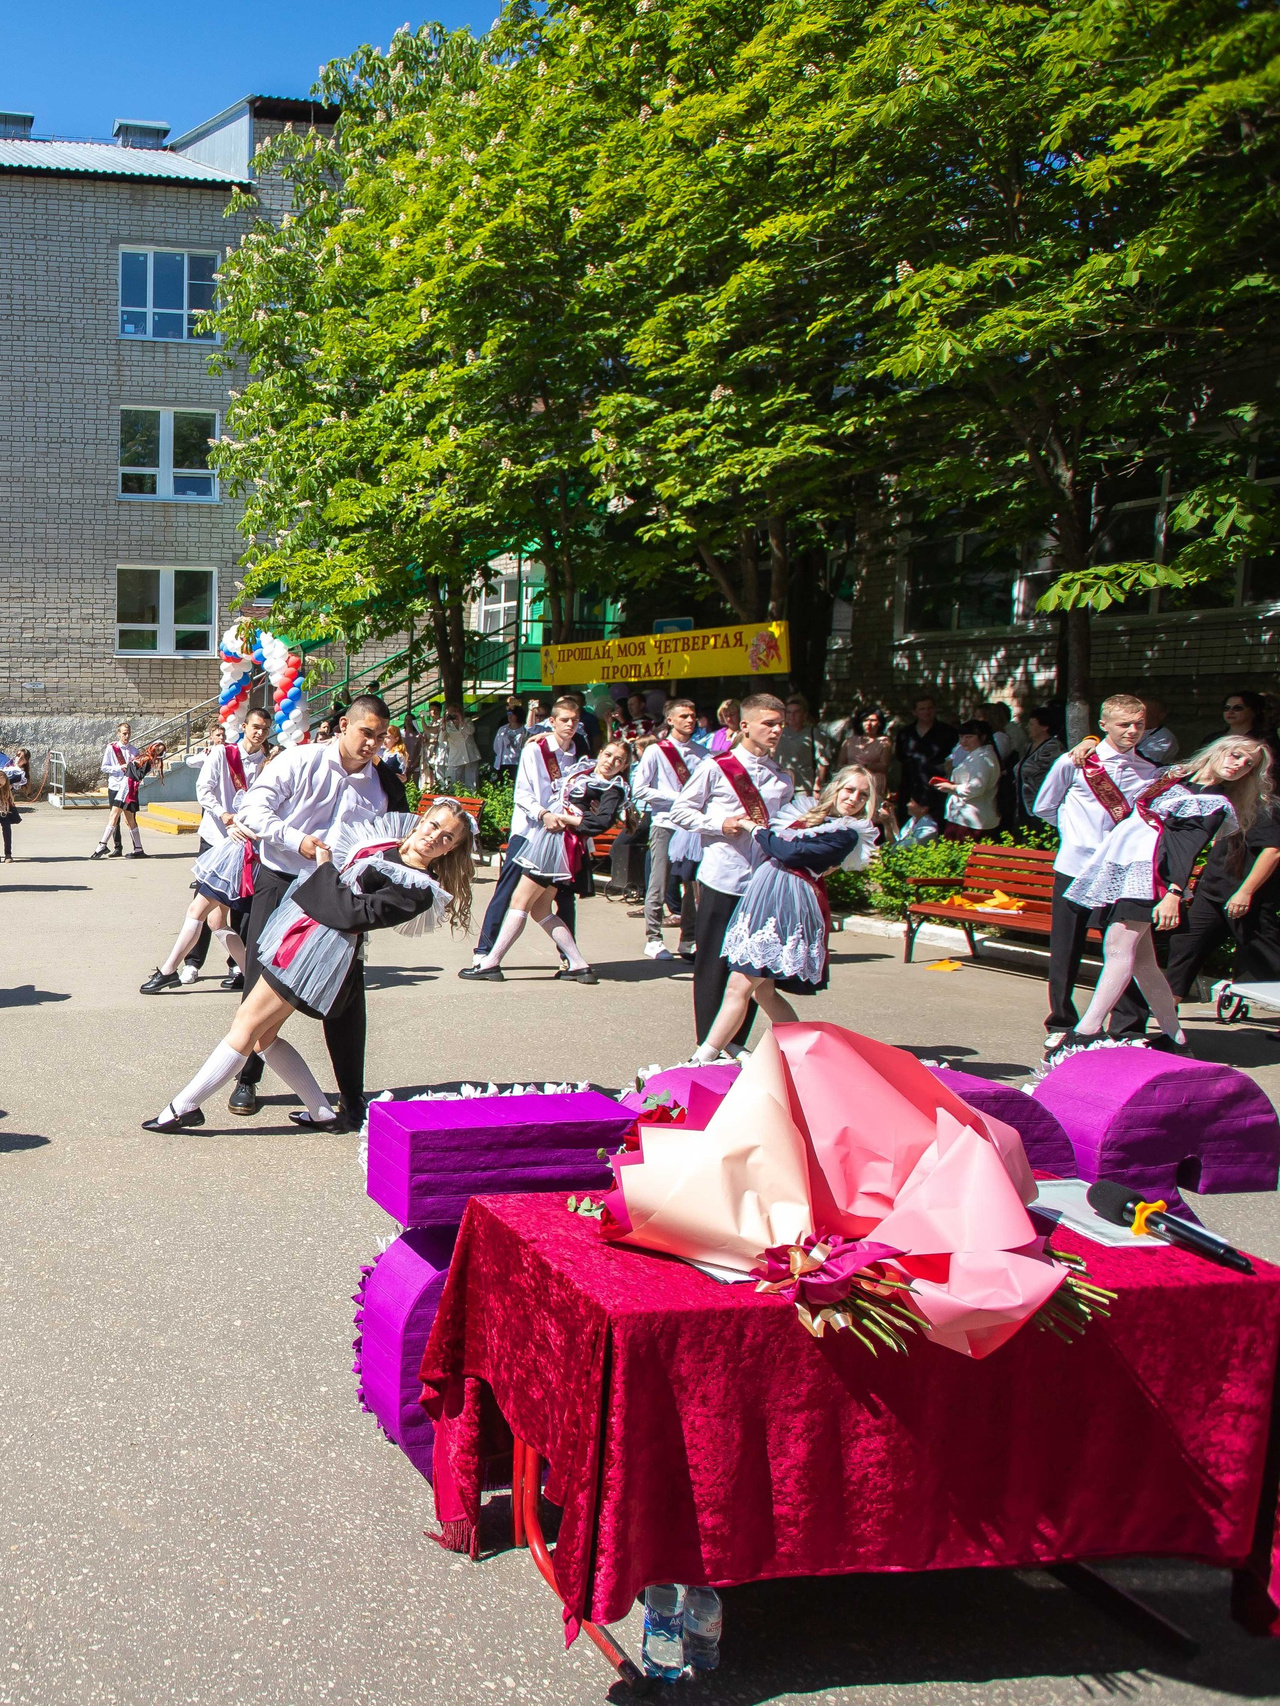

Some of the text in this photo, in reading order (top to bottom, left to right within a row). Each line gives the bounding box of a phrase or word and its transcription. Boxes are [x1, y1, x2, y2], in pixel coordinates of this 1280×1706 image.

[557, 631, 749, 662] ПРОЩАЙ, МОЯ ЧЕТВЕРТАЯ,
[601, 656, 671, 680] ПРОЩАЙ!
